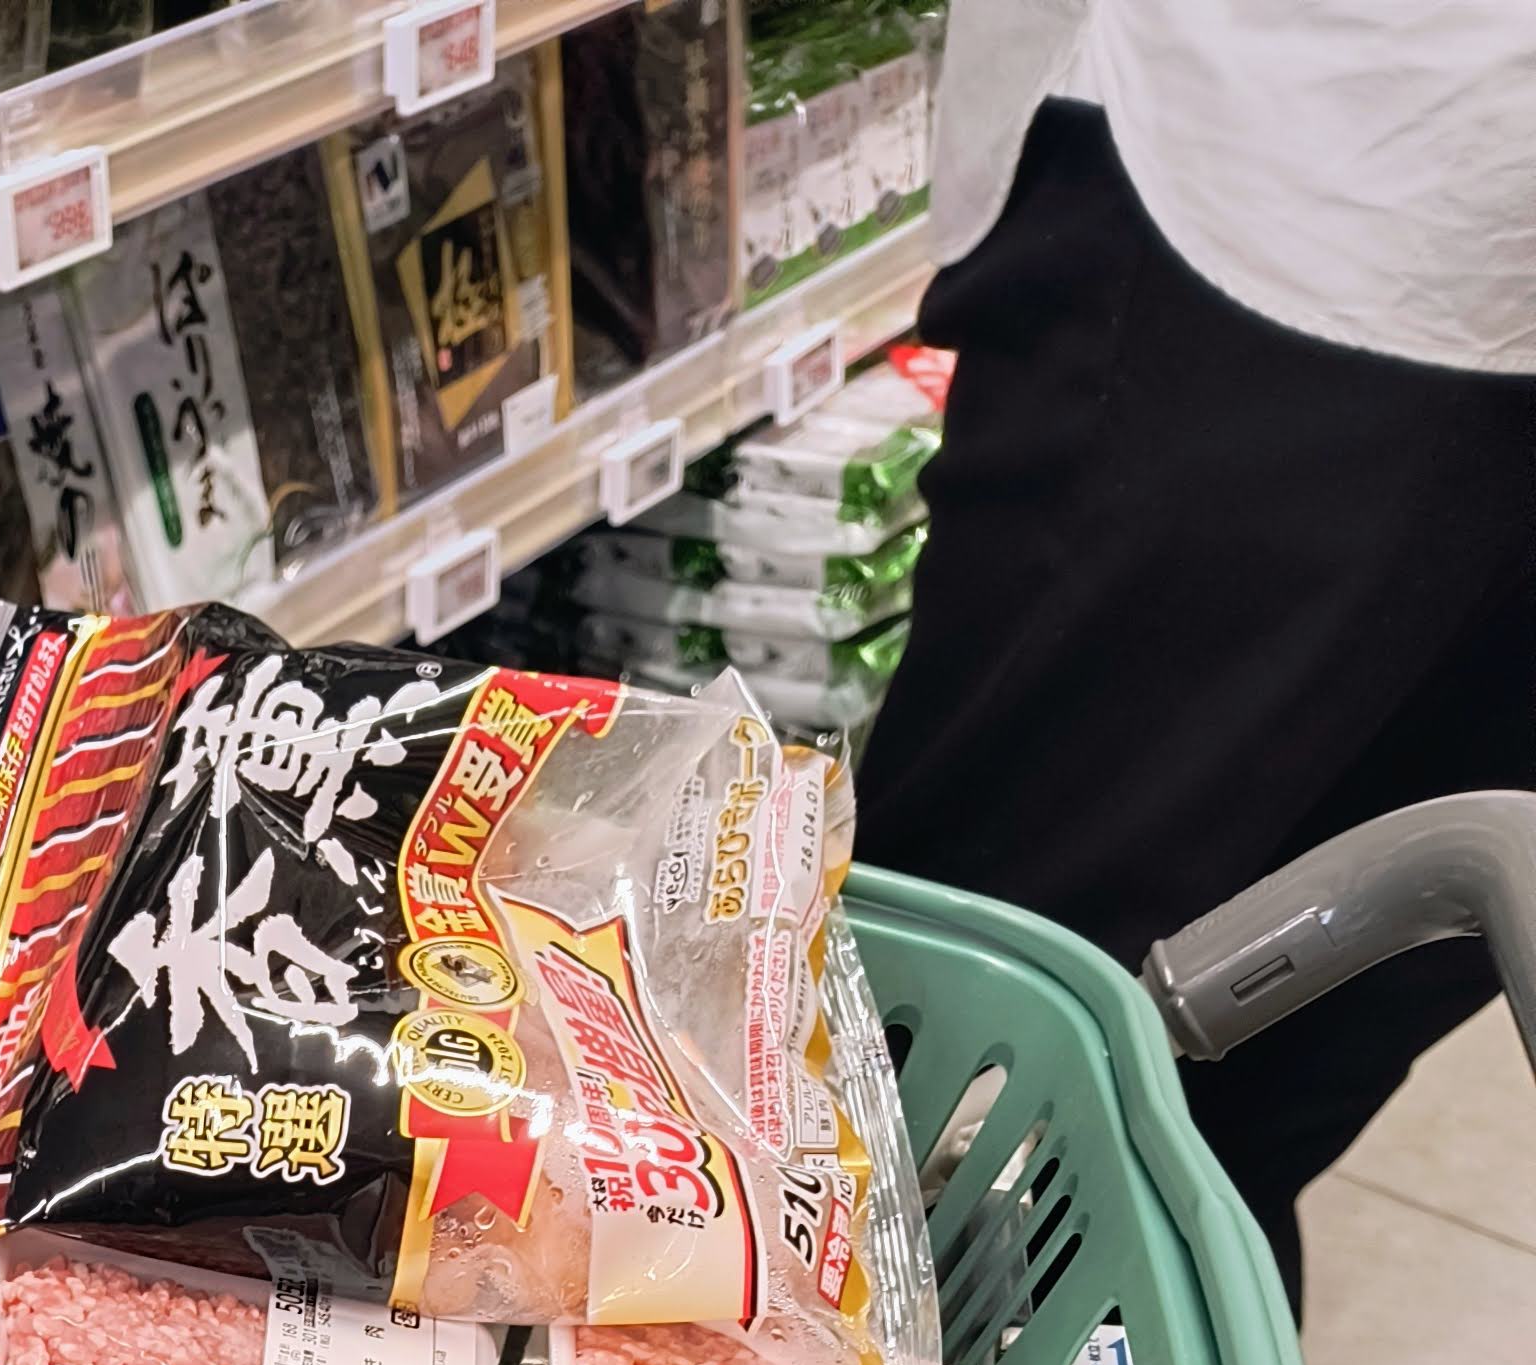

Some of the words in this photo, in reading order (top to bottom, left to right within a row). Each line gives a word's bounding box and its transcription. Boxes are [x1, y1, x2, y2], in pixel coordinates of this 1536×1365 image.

[413, 798, 454, 858] ダブル
[712, 716, 765, 922] あらびきポーク
[353, 858, 389, 973] こうくん
[406, 1014, 464, 1042] QUALITY
[167, 1083, 344, 1181] 特選
[644, 1198, 708, 1236] 今だけ
[777, 1160, 824, 1264] 510
[281, 1322, 298, 1338] 168
[301, 1327, 319, 1345] 301
